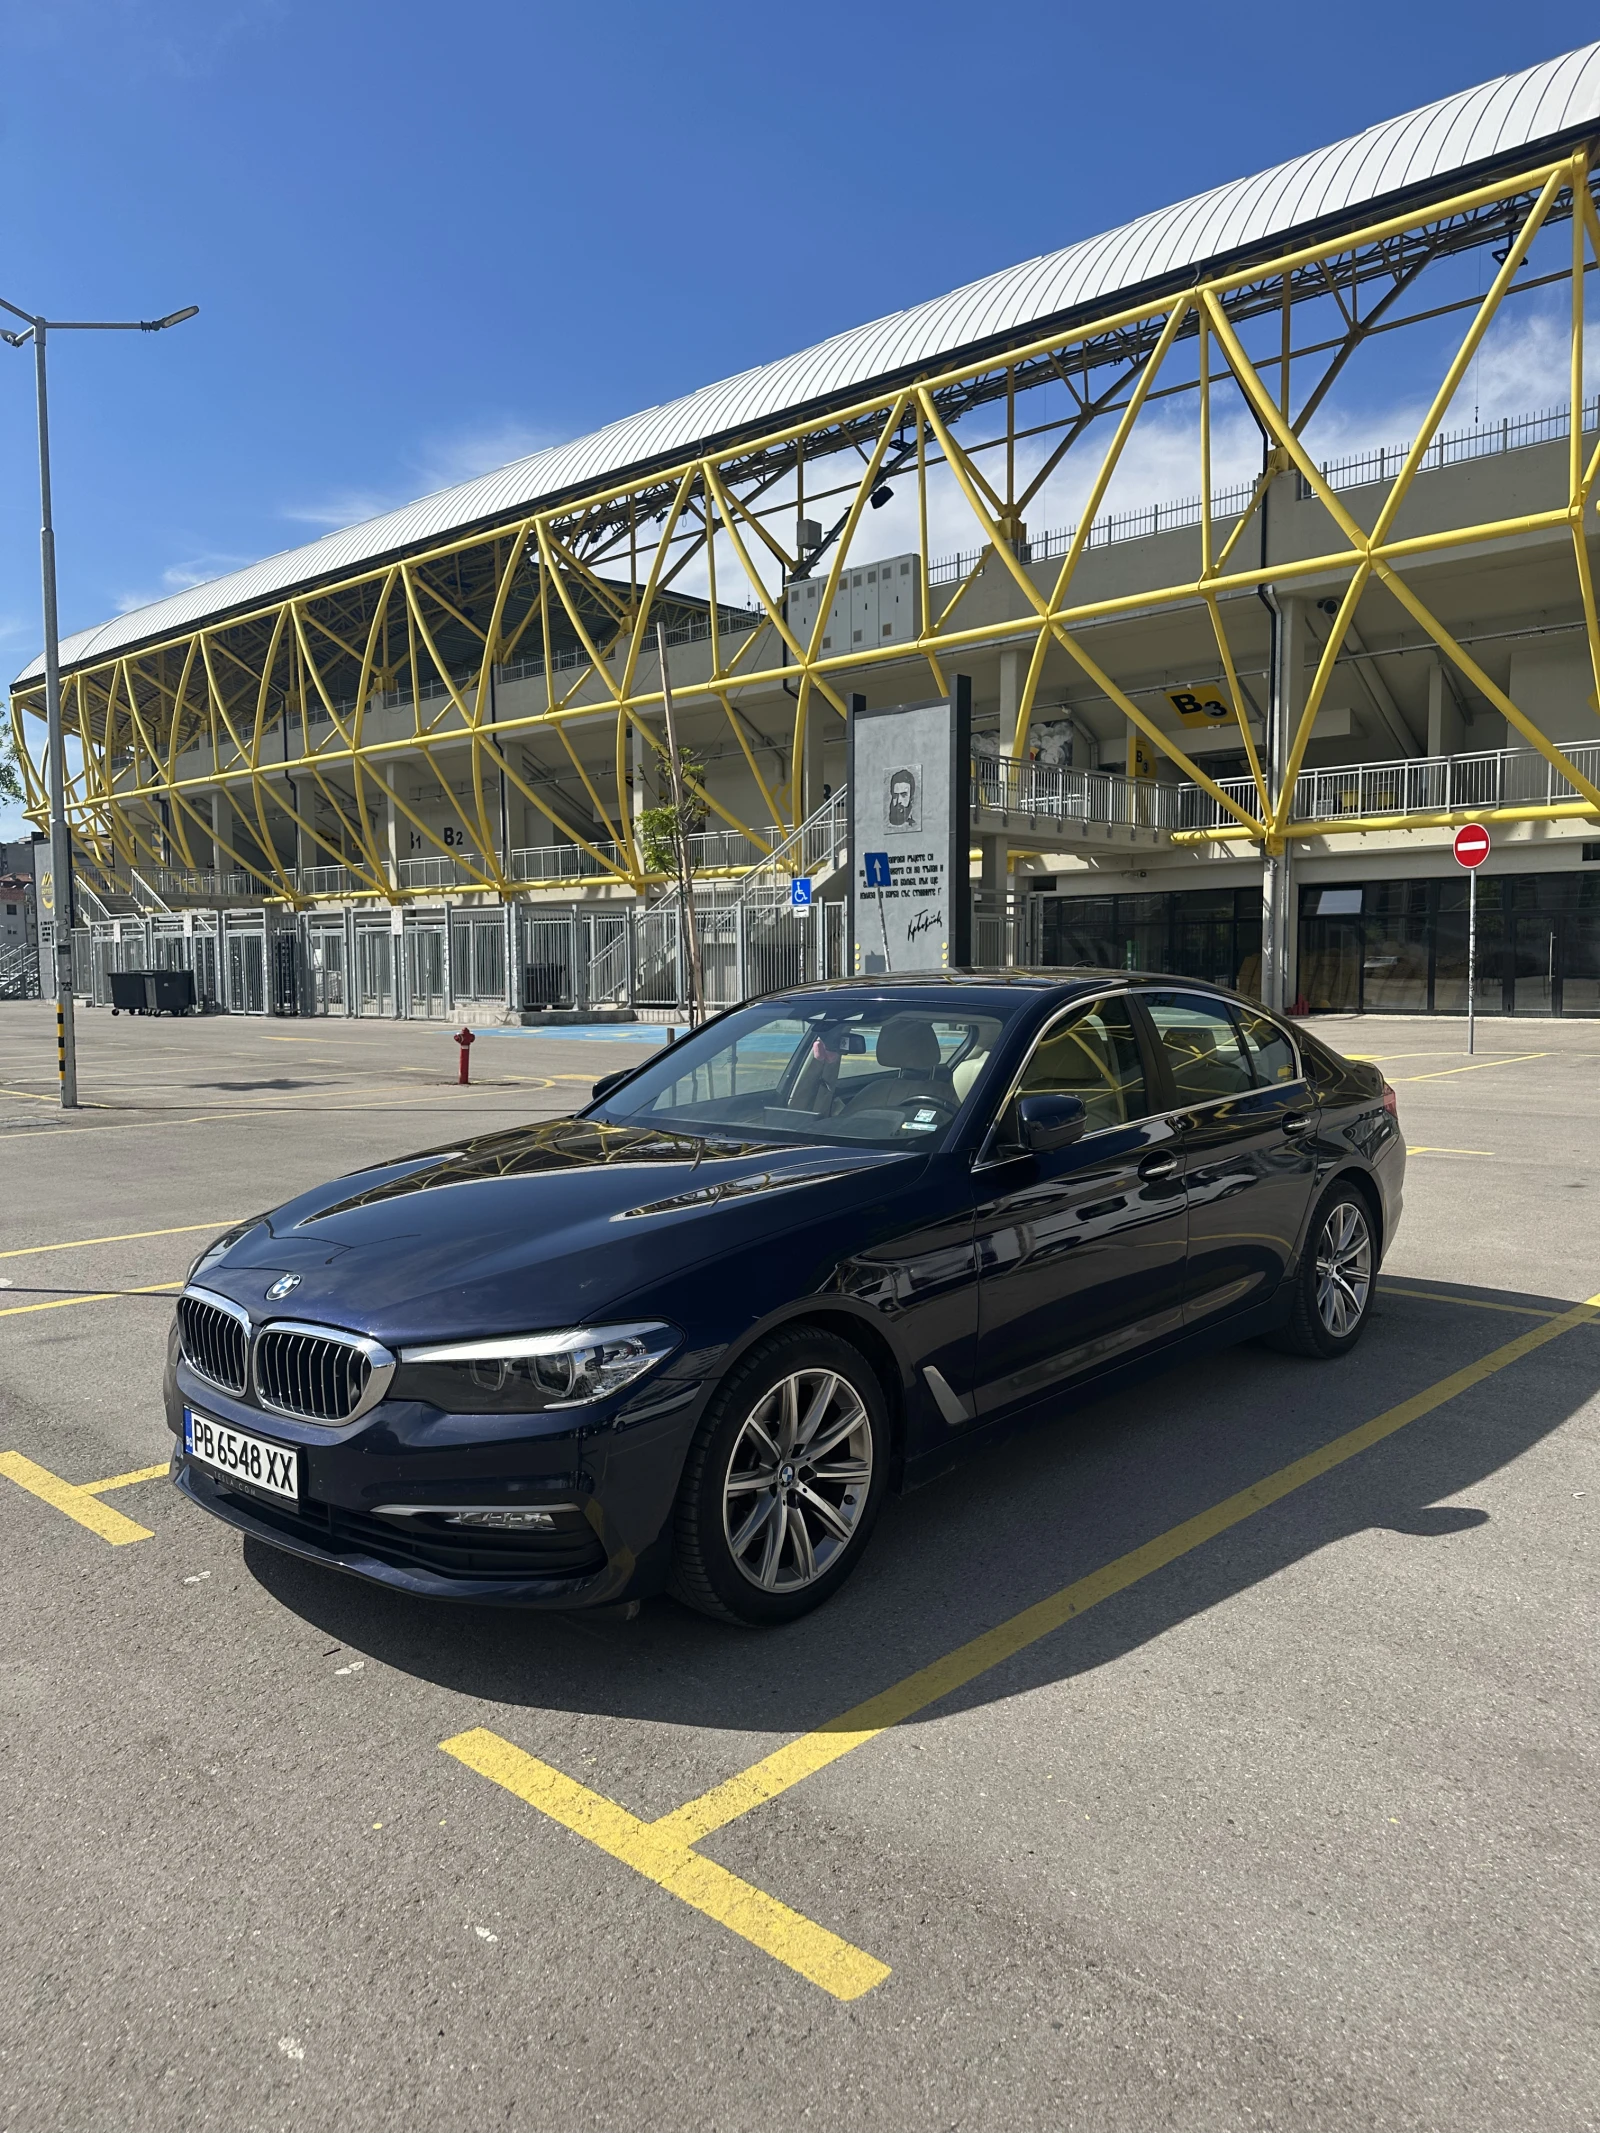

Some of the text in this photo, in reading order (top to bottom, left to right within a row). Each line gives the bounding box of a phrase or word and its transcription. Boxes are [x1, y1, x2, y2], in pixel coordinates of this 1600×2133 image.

[1170, 694, 1227, 716] B3
[444, 827, 463, 846] B2
[193, 1418, 295, 1494] PB 6548 XX
